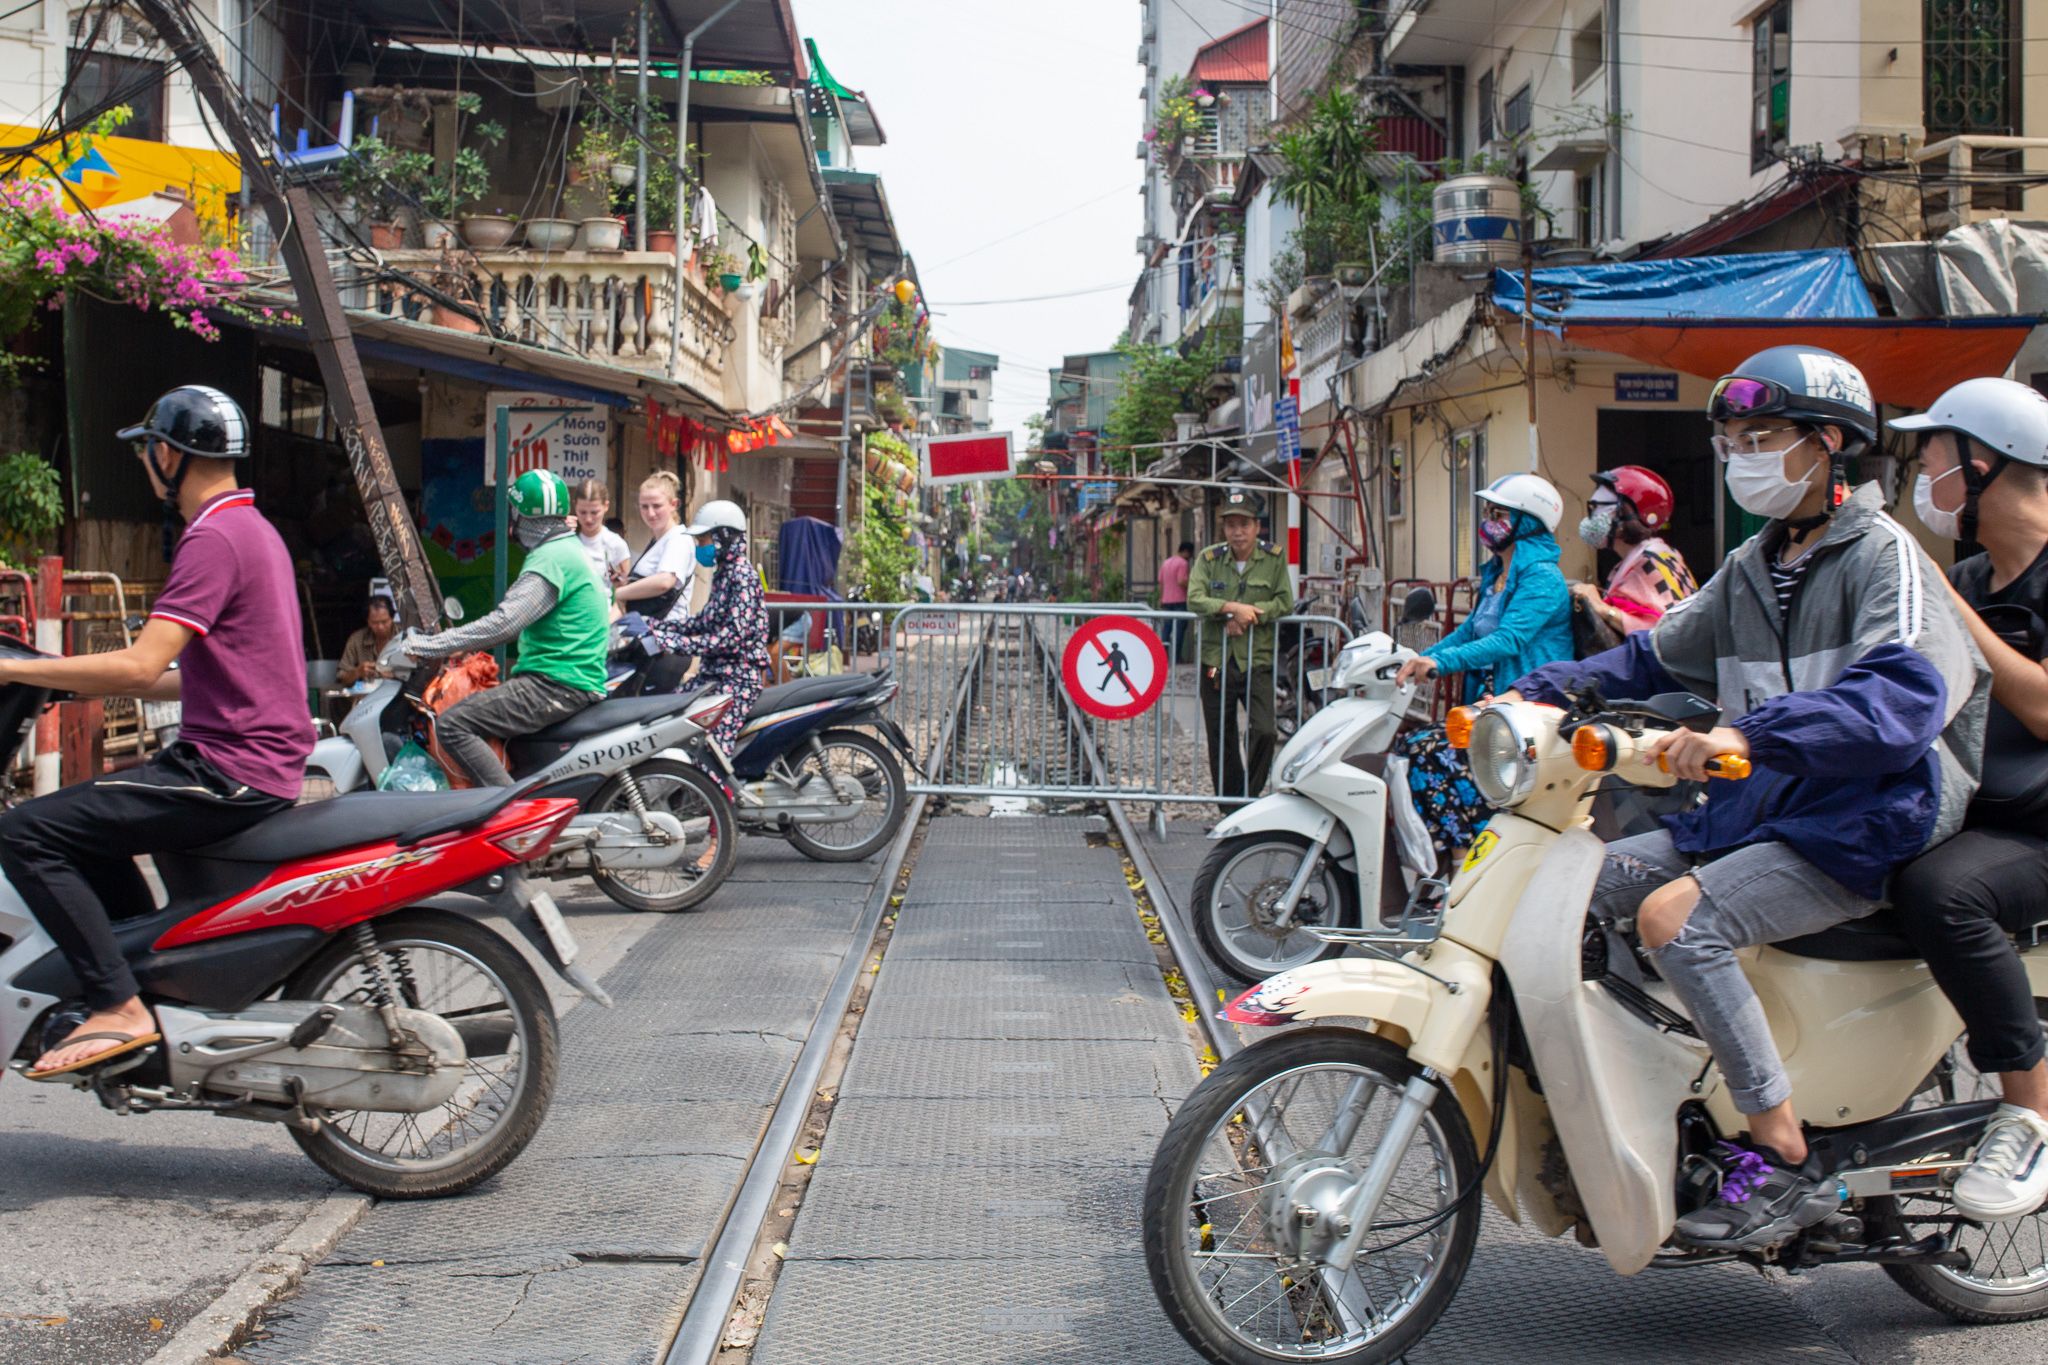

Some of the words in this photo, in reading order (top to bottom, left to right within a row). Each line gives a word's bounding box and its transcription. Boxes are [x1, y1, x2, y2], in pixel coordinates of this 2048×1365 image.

[563, 416, 606, 433] Móng
[563, 433, 600, 446] Sườn
[563, 450, 589, 465] Thịt
[577, 733, 658, 770] SPORT
